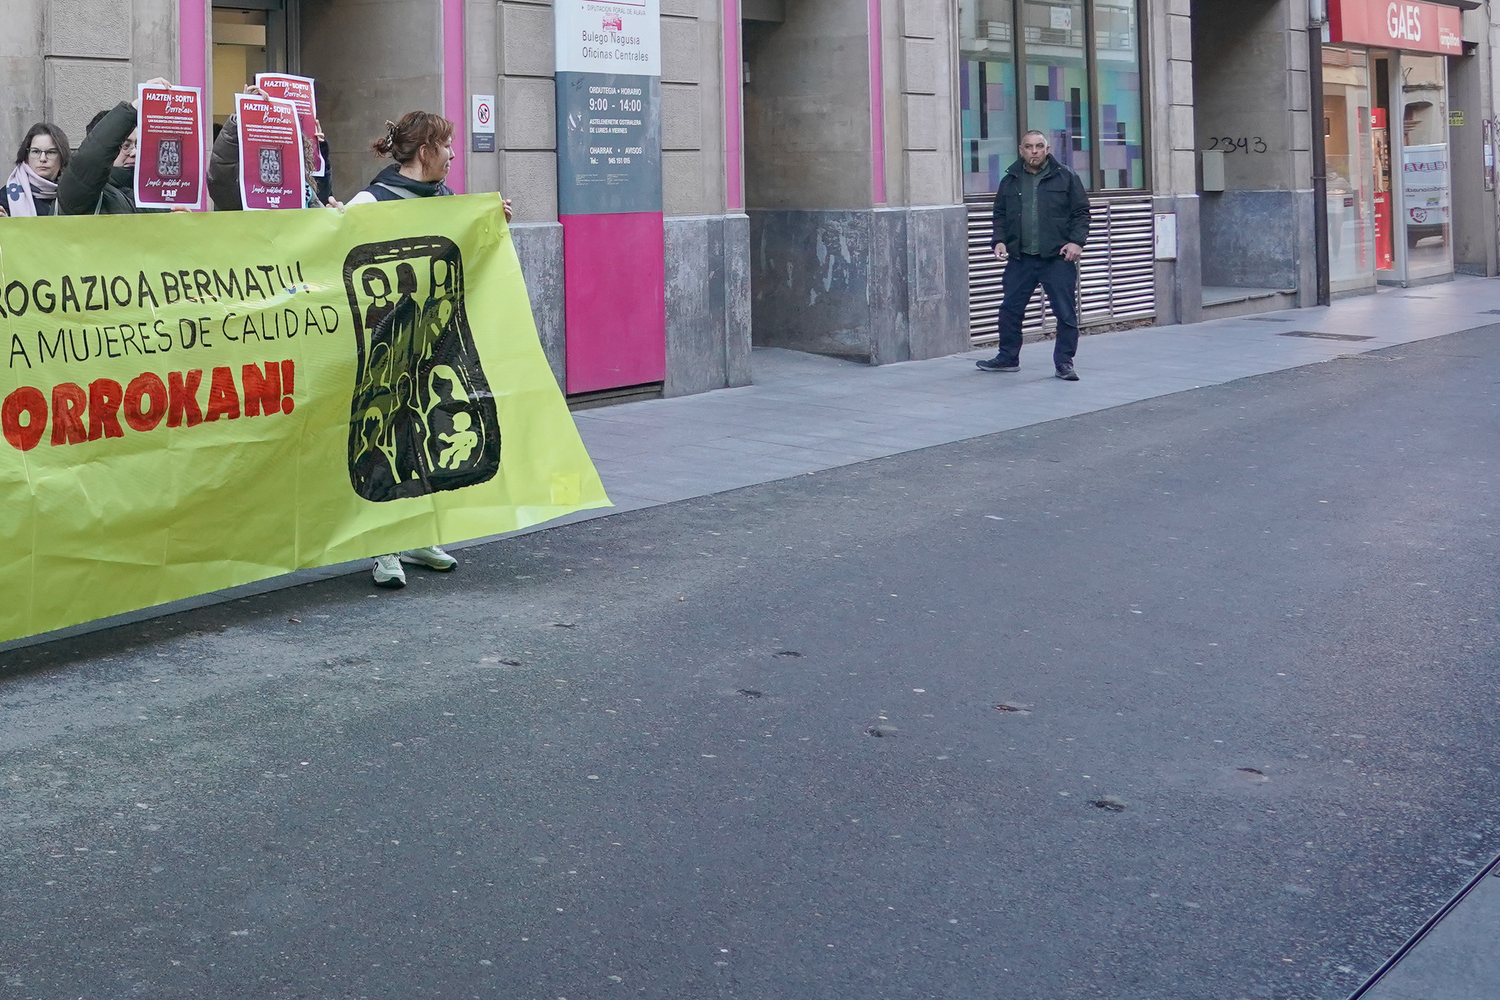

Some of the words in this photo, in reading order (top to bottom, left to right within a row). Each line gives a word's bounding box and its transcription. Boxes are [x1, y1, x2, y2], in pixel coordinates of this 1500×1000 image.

[613, 6, 625, 14] FORAL
[1388, 2, 1421, 41] GAES
[582, 30, 608, 45] Bulego
[610, 32, 640, 46] Nagusia
[582, 47, 612, 60] Oficinas
[615, 49, 648, 61] Centrales
[264, 80, 289, 89] HAZTEN
[292, 82, 309, 91] SORTU
[146, 93, 171, 101] HAZTEN
[175, 94, 194, 103] SORTU
[589, 98, 608, 110] 9:00
[620, 99, 641, 111] 14:00
[165, 101, 193, 114] Borrokan
[244, 103, 269, 112] HAZTEN
[273, 104, 291, 114] SORTU
[263, 111, 291, 124] Borrokan
[1209, 137, 1267, 154] 2343
[161, 189, 177, 197] LAB
[266, 196, 281, 204] LAB
[160, 260, 311, 305] BERMATU!
[9, 333, 32, 369] A
[38, 318, 174, 363] MUJERES
[178, 317, 212, 350] DE
[221, 305, 340, 344] CALIDAD
